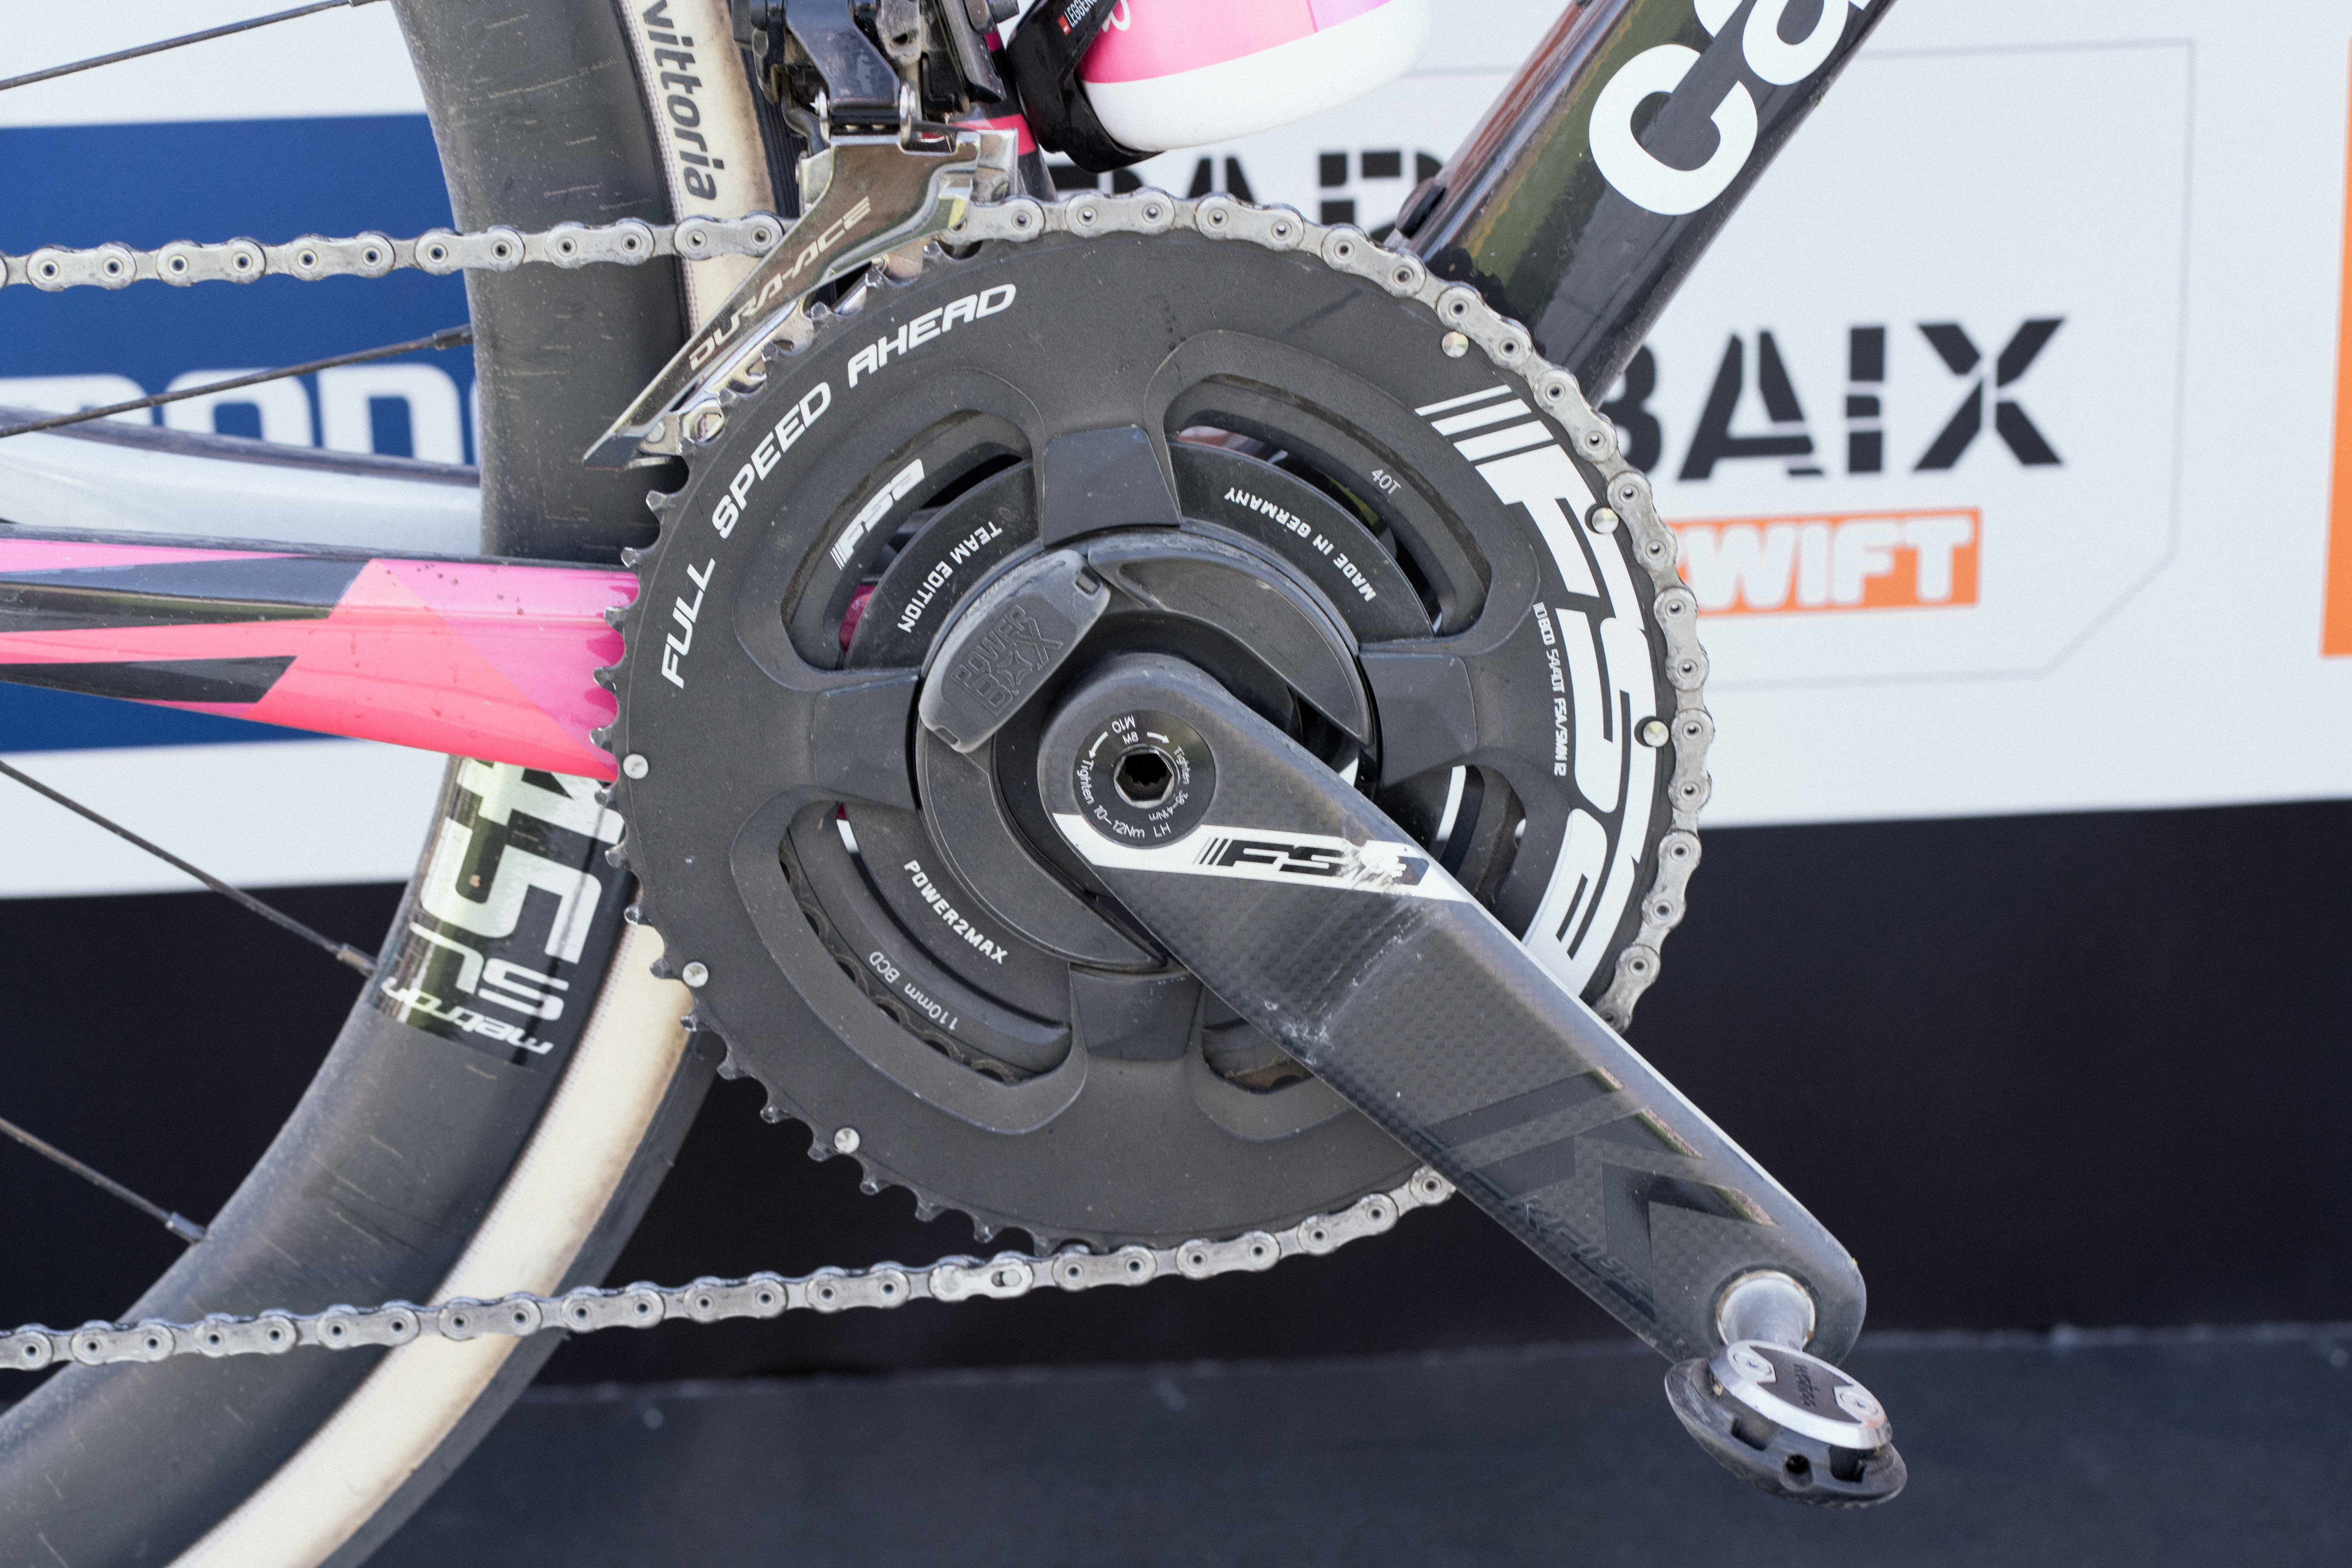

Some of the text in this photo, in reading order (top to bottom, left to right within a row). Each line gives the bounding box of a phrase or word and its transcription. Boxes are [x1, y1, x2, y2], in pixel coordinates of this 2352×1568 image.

[1064, 0, 1097, 28] LEGGER
[642, 0, 724, 200] vittoria
[1589, 0, 1868, 216] ca
[689, 196, 871, 371] DURA-ACE
[661, 283, 1017, 689] FULL SPEED AHEAD
[837, 458, 926, 566] FSA
[1371, 468, 1402, 495] 40T
[897, 521, 1003, 633] TEAM EDITION
[1224, 486, 1377, 602] MADE IN GERMANY
[1668, 514, 1972, 610] WIFT
[950, 604, 1028, 689] POWER
[1111, 715, 1136, 734] M10
[1122, 731, 1139, 745] M8
[1173, 745, 1191, 785] Tighten
[1076, 759, 1095, 805] Tighten
[1154, 822, 1172, 838] LH
[904, 860, 1009, 964] POWER2MAX
[382, 977, 555, 1054] metron
[869, 950, 958, 1031] 110mm BCD
